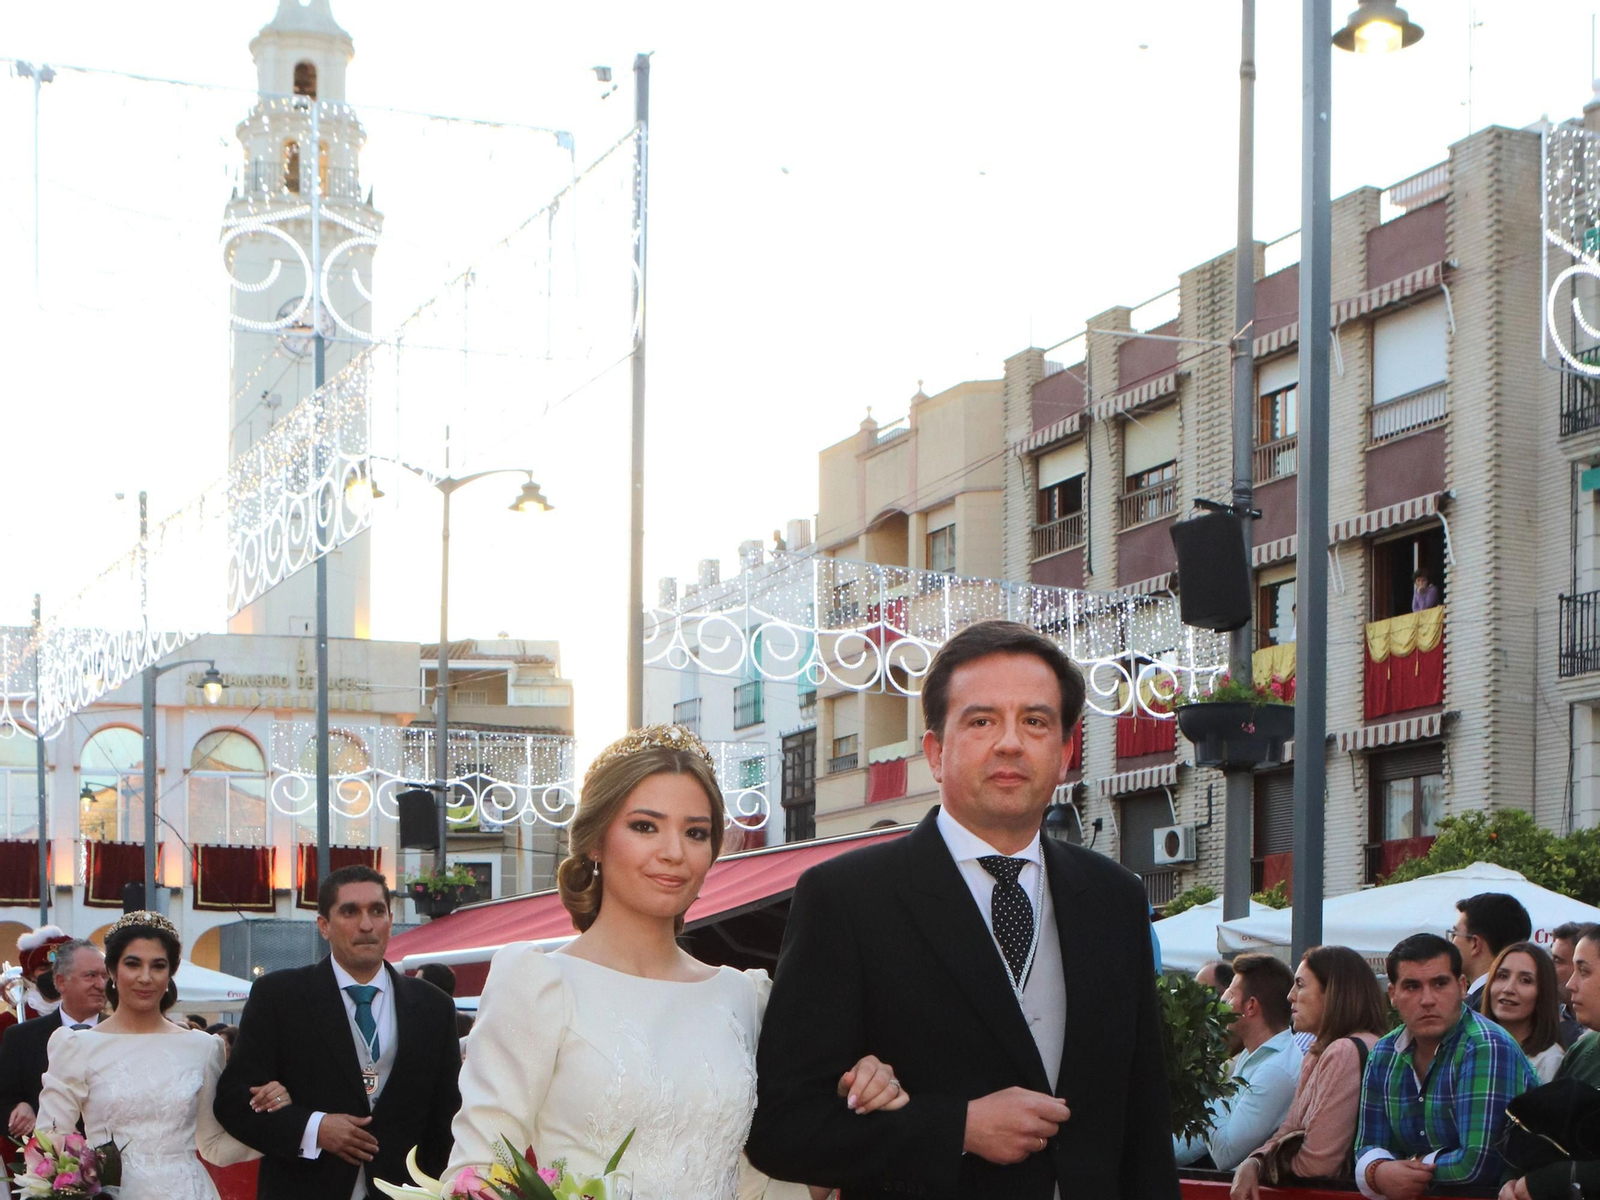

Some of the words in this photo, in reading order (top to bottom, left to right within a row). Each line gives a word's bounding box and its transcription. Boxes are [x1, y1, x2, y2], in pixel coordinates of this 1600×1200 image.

[186, 672, 290, 688] AYTAMIENTO
[298, 677, 314, 690] DE
[326, 677, 372, 691] UCENA
